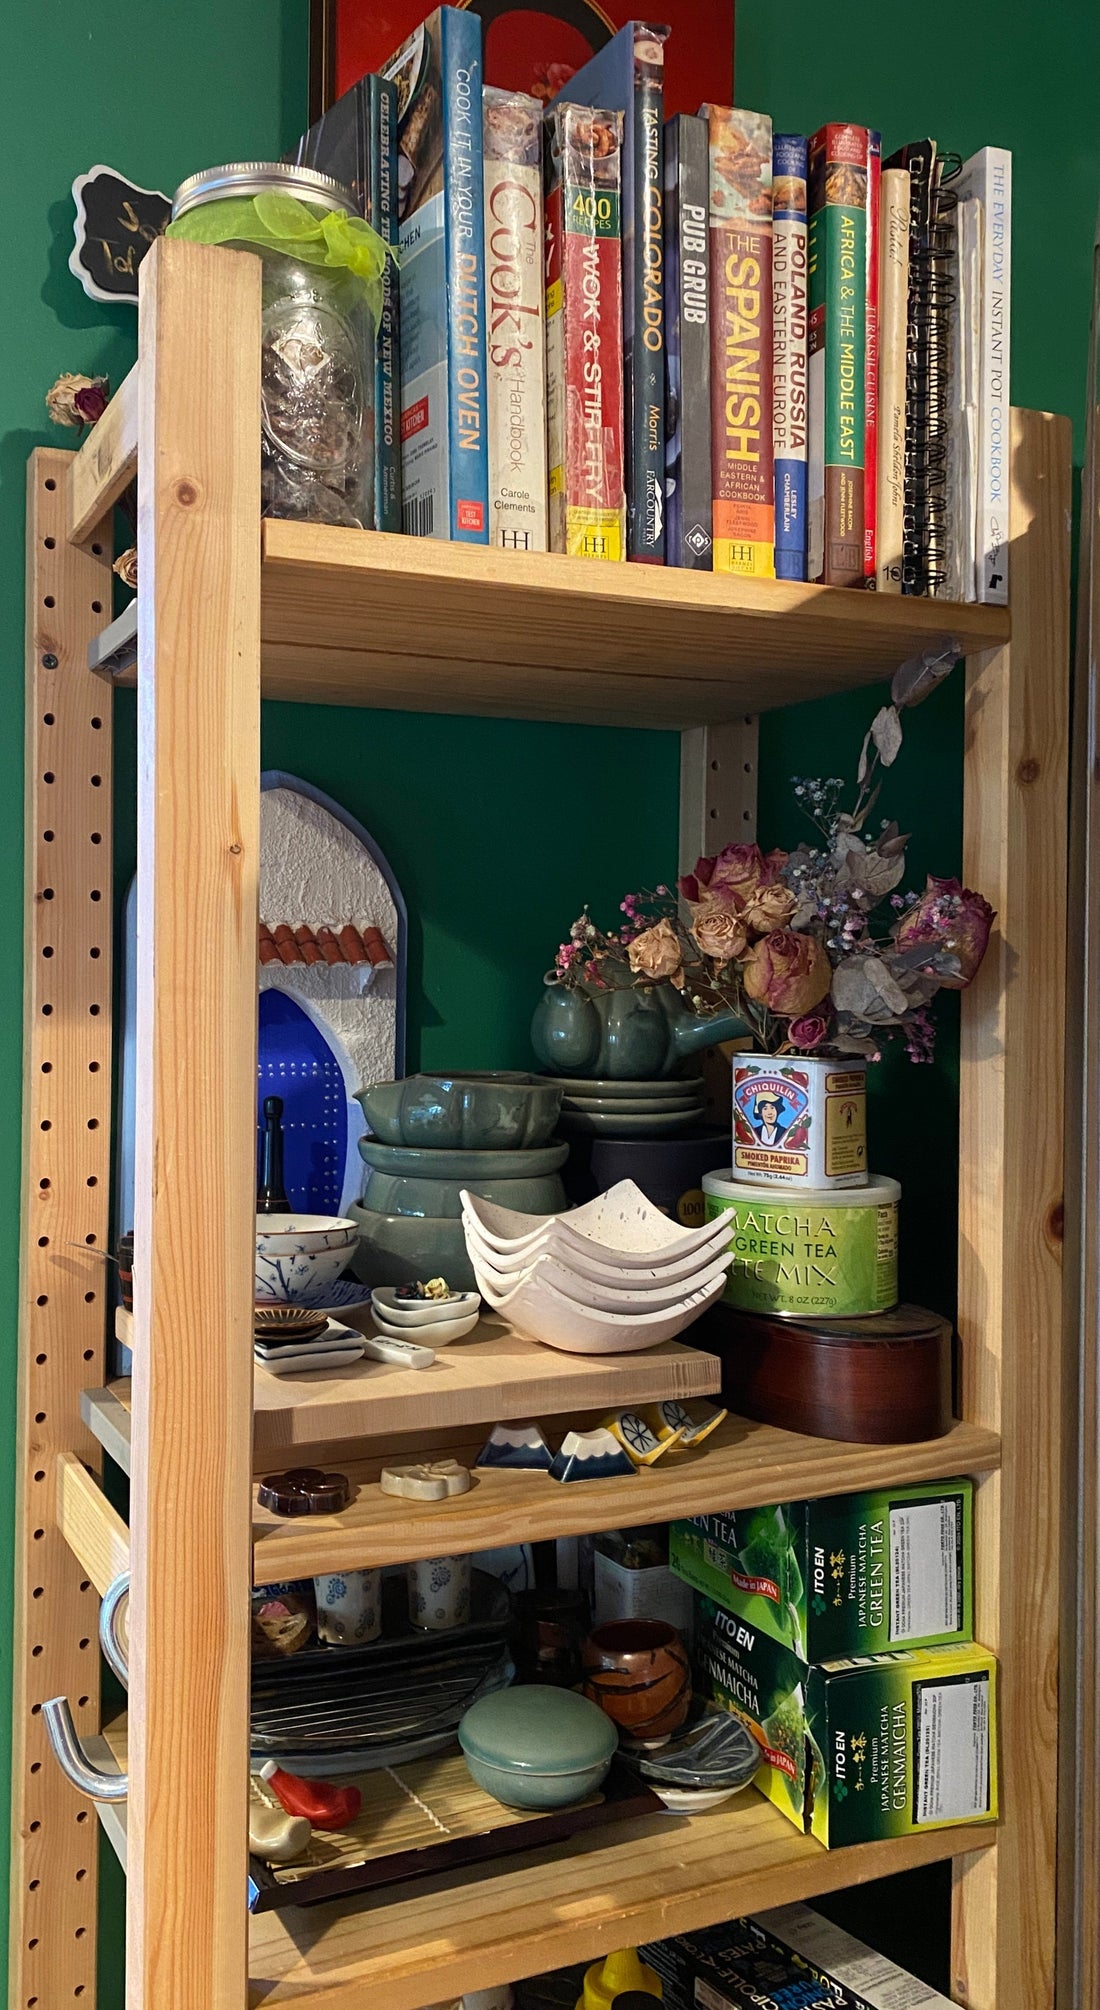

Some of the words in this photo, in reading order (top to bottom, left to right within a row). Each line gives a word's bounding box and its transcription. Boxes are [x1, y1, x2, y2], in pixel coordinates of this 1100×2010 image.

[456, 69, 471, 124] COOK
[380, 92, 390, 212] CELEBRATING
[457, 132, 472, 151] IT
[643, 107, 659, 180] TASTING
[458, 159, 472, 178] IN
[994, 164, 1005, 195] THE
[458, 186, 473, 238] YOUR
[573, 194, 611, 220] 400
[573, 216, 612, 229] RECIPES
[682, 203, 706, 252] PUB
[526, 241, 536, 265] The
[726, 233, 761, 254] THE
[773, 232, 787, 272] AND
[840, 216, 854, 280] AFRICA
[992, 202, 1004, 285] EVERYDAY
[582, 244, 600, 320] WOK
[642, 188, 663, 351] COLORADO
[789, 233, 806, 343] POLAND,
[458, 253, 478, 357] DUTCH
[682, 259, 707, 324] GRUB
[840, 285, 854, 299] &
[383, 311, 392, 333] OF
[773, 281, 787, 366] EASTERN
[840, 305, 854, 336] THE
[991, 290, 1003, 364] INSTANT
[383, 336, 392, 377] NEW
[583, 330, 601, 353] &
[725, 254, 761, 462] SPANISH
[839, 343, 854, 410] MIDDLE
[991, 369, 1002, 402] POT
[383, 381, 393, 446] MEXICO
[458, 370, 481, 451] OVEN
[773, 370, 787, 449] EUROPE
[790, 352, 806, 449] RUSSIA
[866, 371, 876, 427] CUISINE
[510, 378, 526, 472] Handbook
[649, 404, 661, 451] Morris
[840, 415, 854, 459] EAST
[891, 405, 901, 442] Pamela
[727, 462, 758, 472] MIDDLE
[889, 444, 901, 480] Sheldon
[990, 407, 1001, 503] COOKBOOK
[500, 487, 530, 500] Carole
[719, 490, 766, 502] COOKBOOK
[720, 471, 758, 482] EASTERN
[725, 481, 760, 492] AFRICAN
[494, 500, 536, 514] Clements
[645, 469, 656, 548] FARCOUNTRY
[864, 529, 873, 561] English
[745, 1082, 796, 1100] CHIQUILÍN
[741, 1151, 769, 1162] SMOKED
[770, 1154, 801, 1166] PAPRIKA
[735, 1236, 795, 1257] GREEN
[804, 1242, 837, 1258] TEA
[775, 1263, 837, 1287] MIX
[796, 1296, 809, 1305] OZ
[811, 1296, 837, 1307] (227g)
[713, 1517, 738, 1549] TEA
[858, 1524, 867, 1572] MATCHA
[870, 1520, 884, 1557] TEA
[814, 1547, 825, 1567] EN
[848, 1554, 857, 1599] Premium
[756, 1580, 777, 1597] JAPAN
[814, 1568, 825, 1594] ITO
[858, 1573, 867, 1627] JAPANESE
[870, 1562, 884, 1627] GREEN
[715, 1610, 737, 1637] ITO
[735, 1628, 755, 1651] EN
[703, 1654, 760, 1716] ENMAICHA
[727, 1659, 759, 1690] MATCHA
[835, 1730, 846, 1751] EN
[880, 1705, 889, 1756] MATCHA
[835, 1753, 846, 1779] ITO
[870, 1737, 879, 1783] Premium
[892, 1702, 906, 1810] GENMAICHA
[881, 1758, 890, 1812] JAPANESE
[718, 1967, 779, 2010] CIPOLLE
